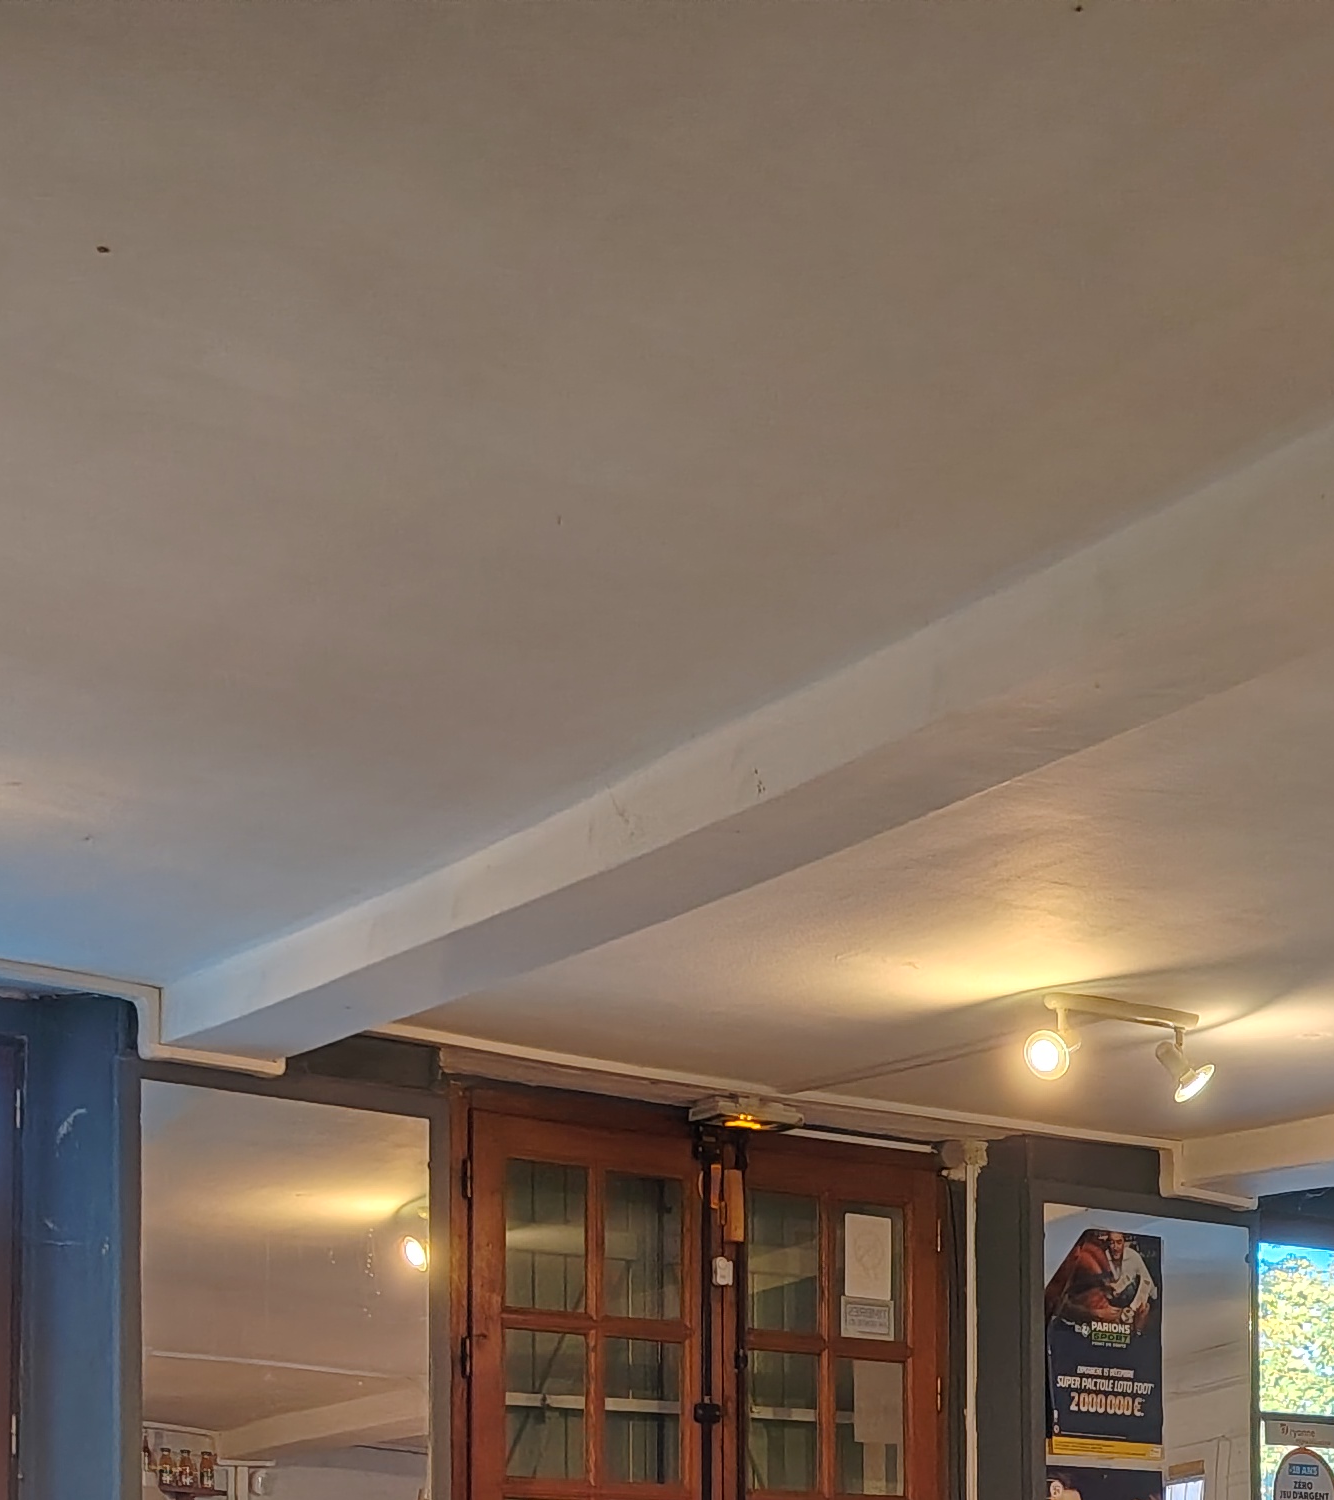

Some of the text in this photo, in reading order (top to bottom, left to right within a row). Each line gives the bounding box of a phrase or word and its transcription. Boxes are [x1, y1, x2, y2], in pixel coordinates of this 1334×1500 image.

[1091, 1321, 1131, 1334] PARIONS
[1093, 1332, 1129, 1343] SPORT
[1056, 1376, 1081, 1389] SUPER
[1081, 1378, 1114, 1392] PACTOLE
[1114, 1380, 1133, 1394] LOTO
[1301, 1466, 1318, 1475] ANS
[1293, 1479, 1313, 1490] ZÉRO
[1280, 1490, 1329, 1500] JEU D'ARGENT
